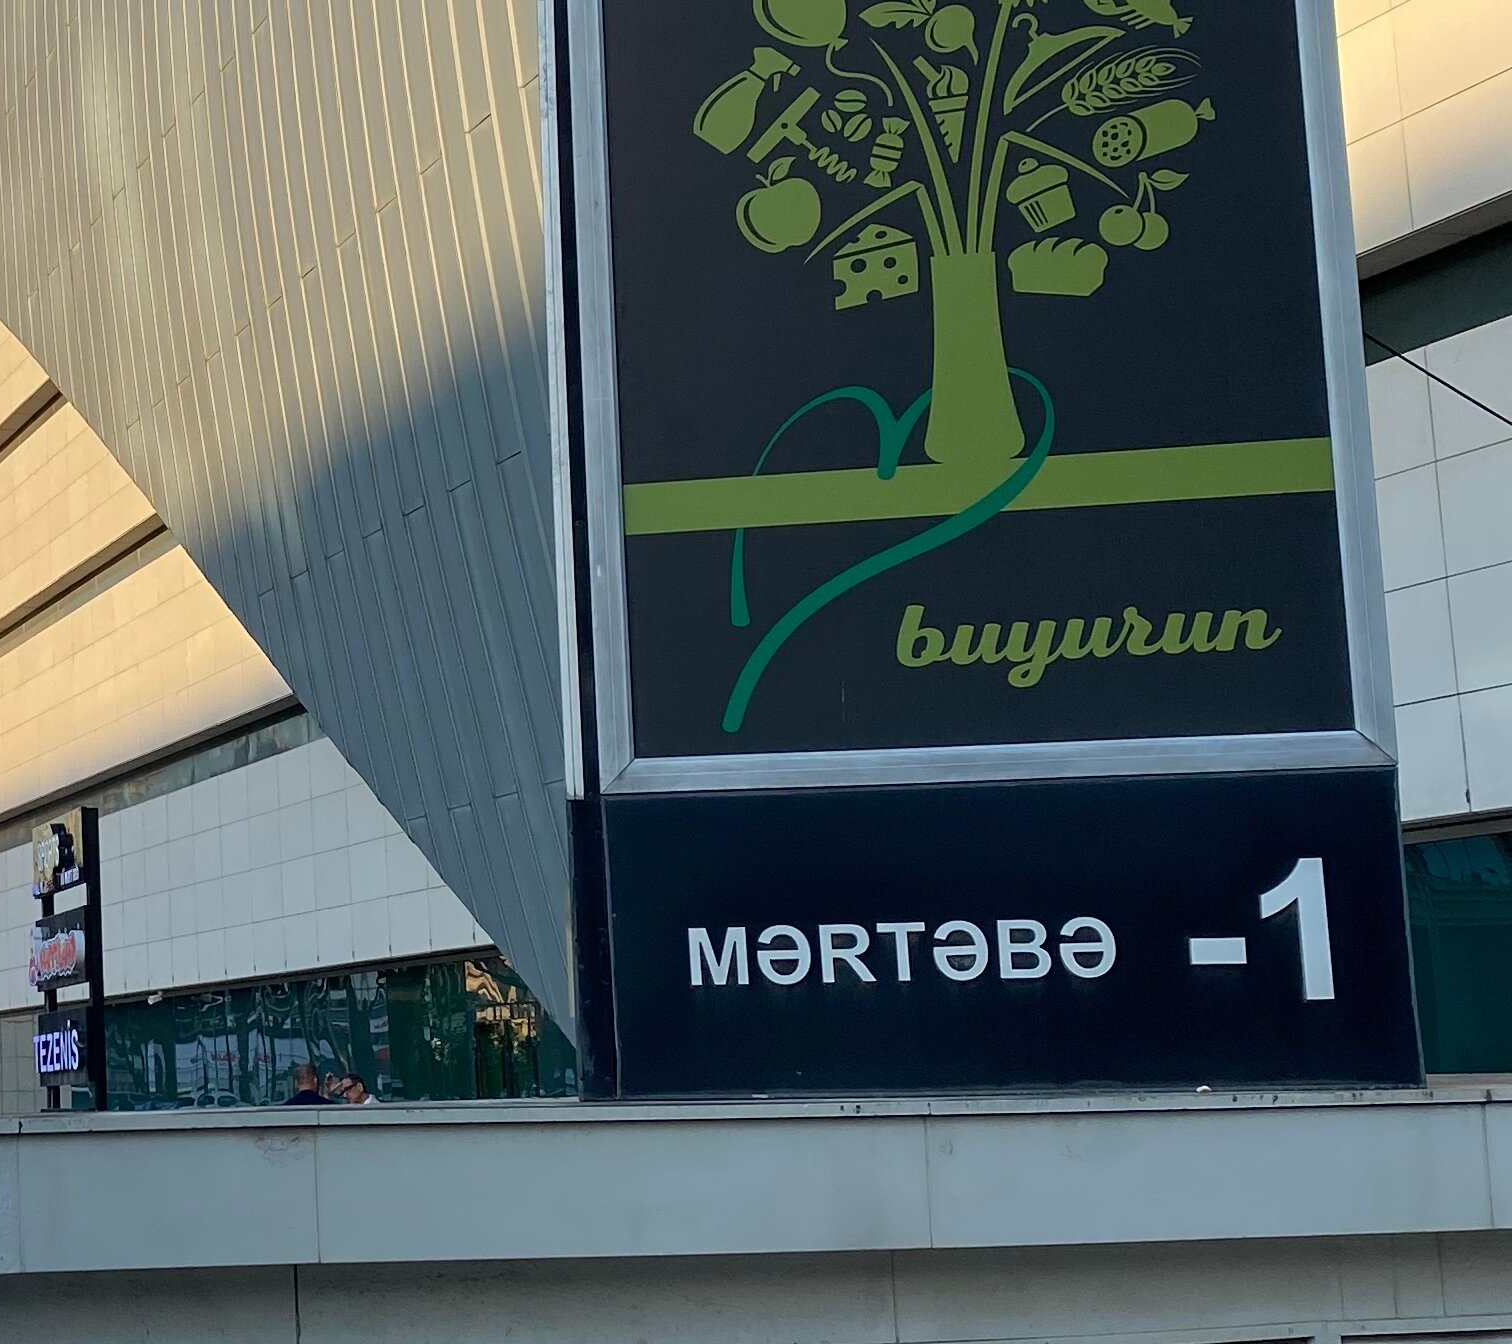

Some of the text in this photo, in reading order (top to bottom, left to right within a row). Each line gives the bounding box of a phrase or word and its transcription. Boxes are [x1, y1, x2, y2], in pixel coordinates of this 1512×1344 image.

[896, 603, 1283, 689] buyurun
[687, 856, 1336, 1002] MƏRTƏBƏ -1
